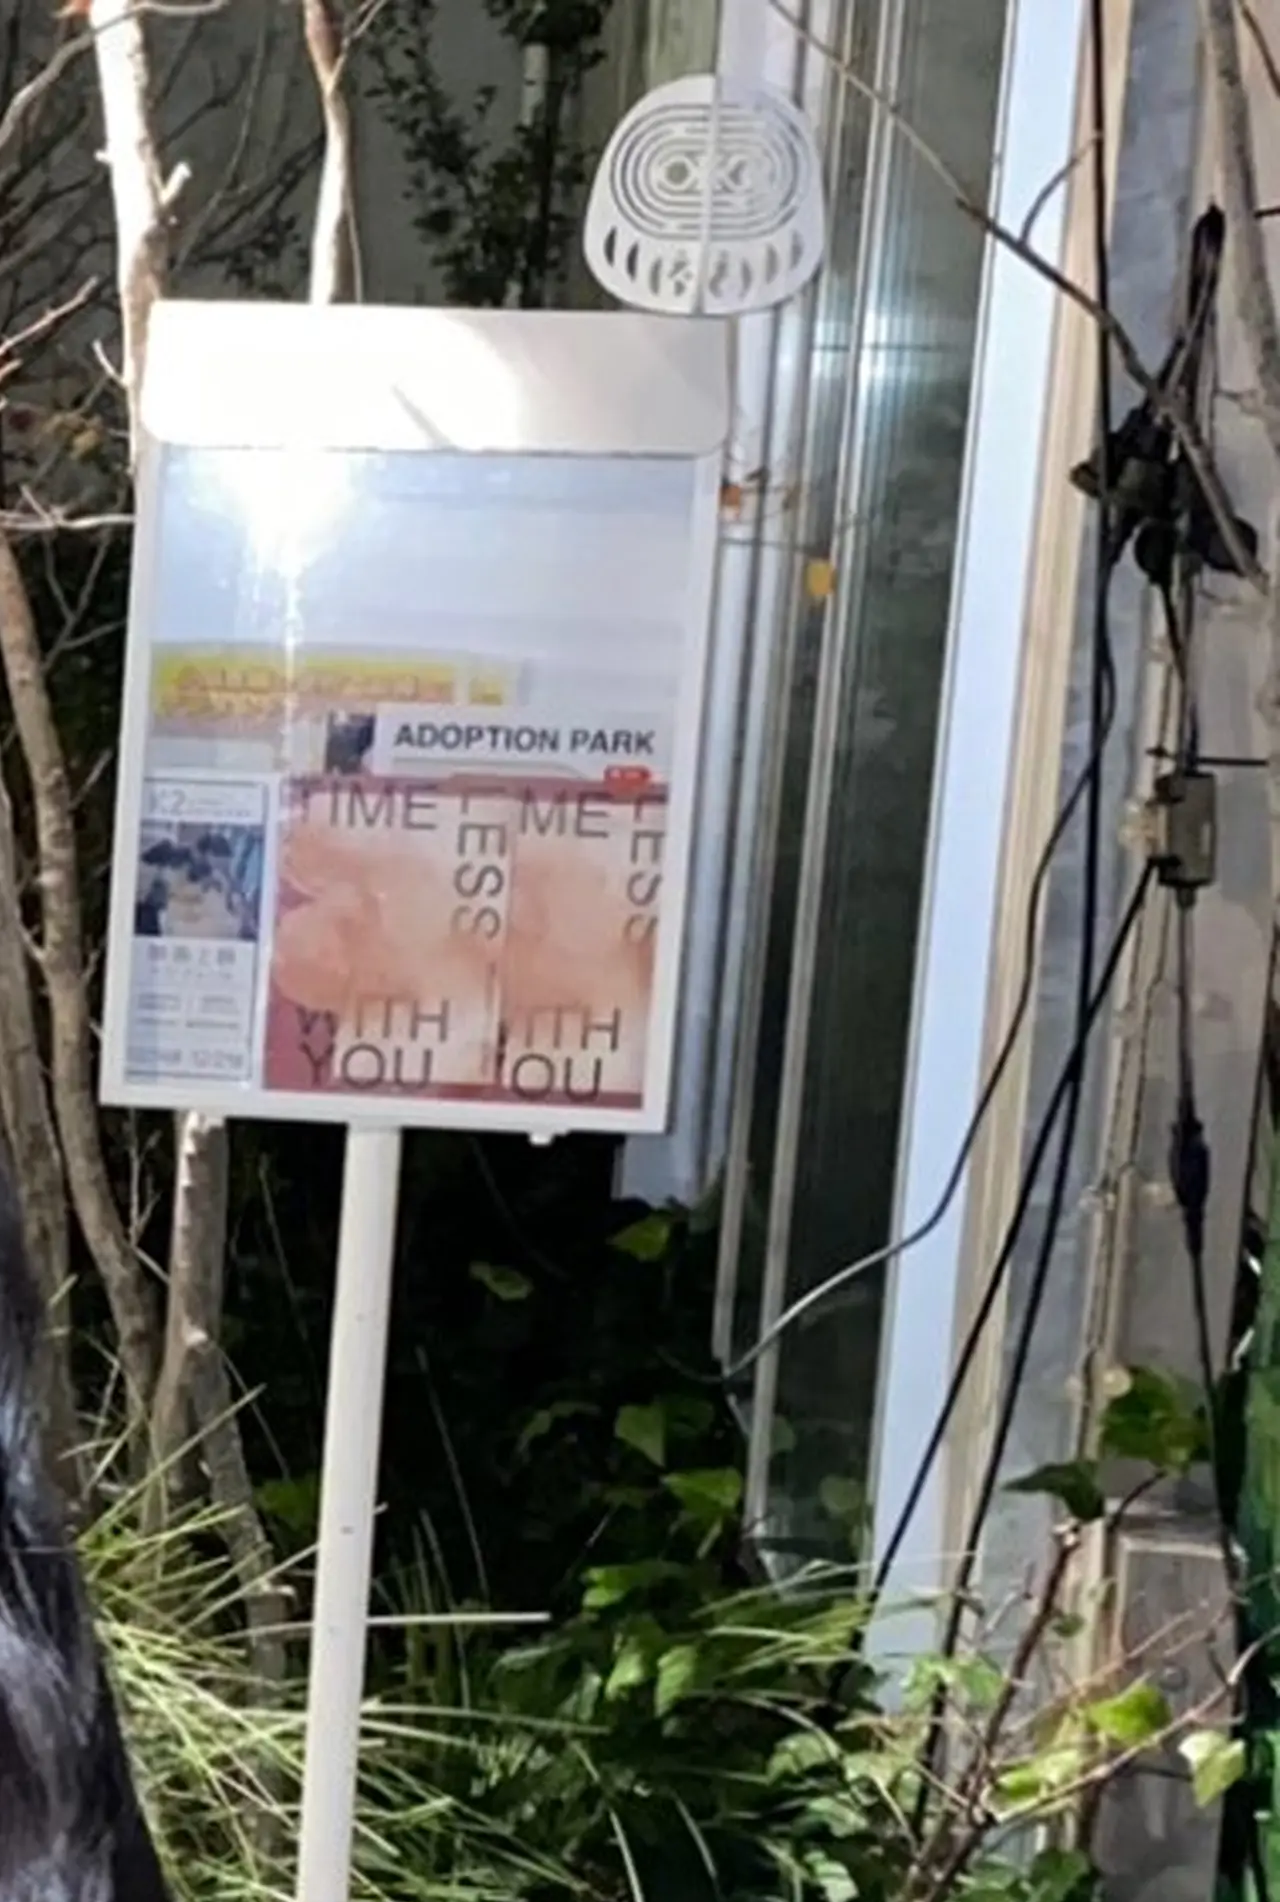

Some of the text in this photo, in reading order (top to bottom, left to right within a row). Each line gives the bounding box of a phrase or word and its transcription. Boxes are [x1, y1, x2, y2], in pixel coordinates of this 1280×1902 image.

[393, 723, 656, 755] ADOPTION PARK
[291, 776, 438, 830] TIME
[518, 786, 611, 839] ME
[449, 784, 507, 941] LESS
[497, 1005, 622, 1052] ITH
[299, 1040, 434, 1091] YOU
[494, 1052, 603, 1101] OU
